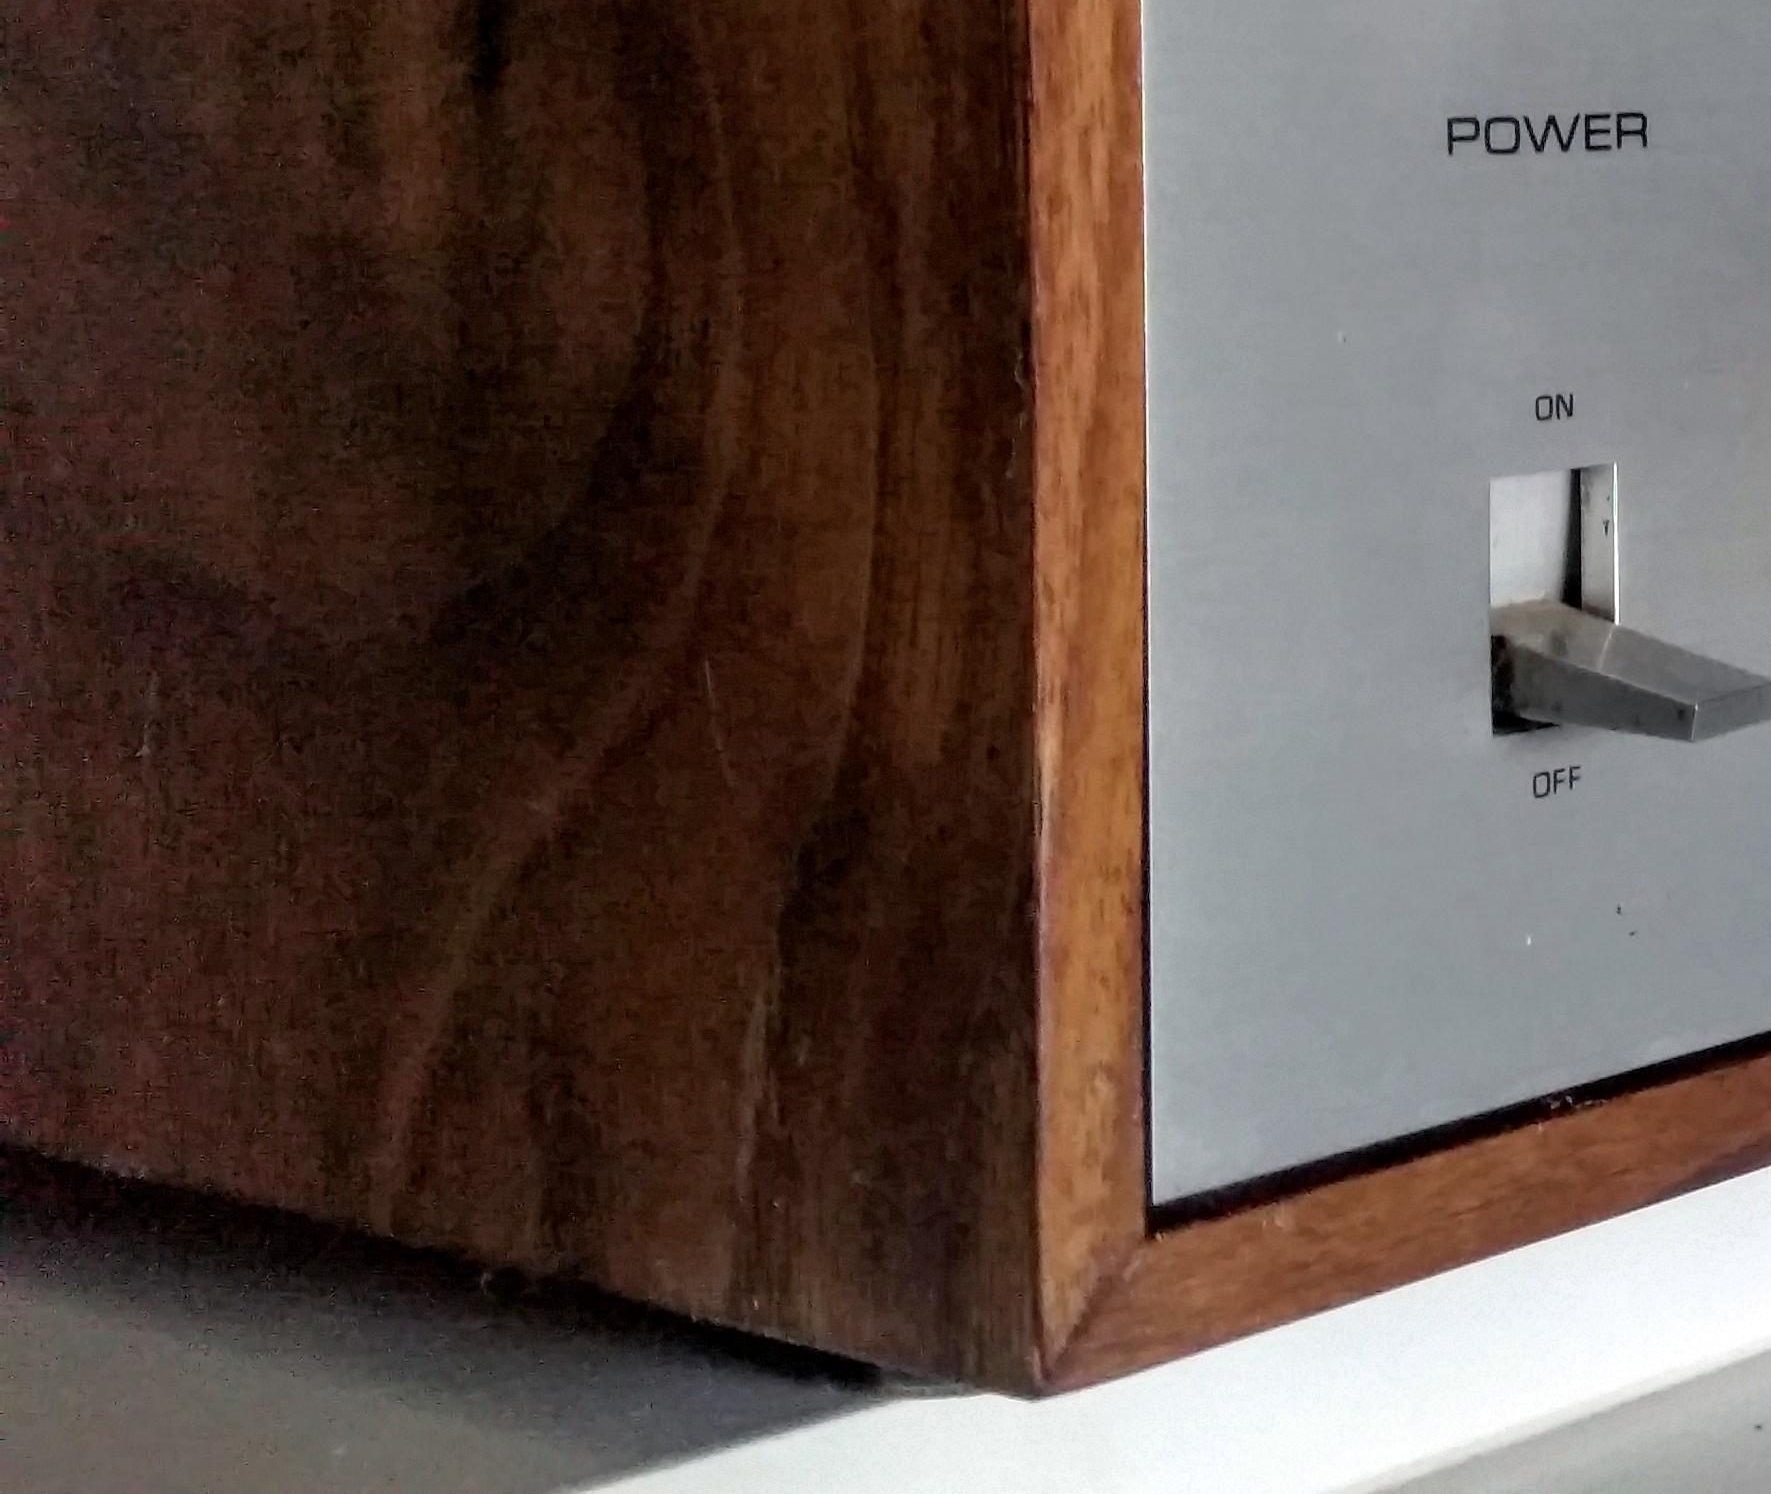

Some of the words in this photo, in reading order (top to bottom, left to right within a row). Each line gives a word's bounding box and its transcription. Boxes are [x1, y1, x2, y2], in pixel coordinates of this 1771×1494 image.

[1447, 111, 1648, 156] POWER
[1535, 393, 1574, 422] ON
[1532, 765, 1581, 799] OFF
